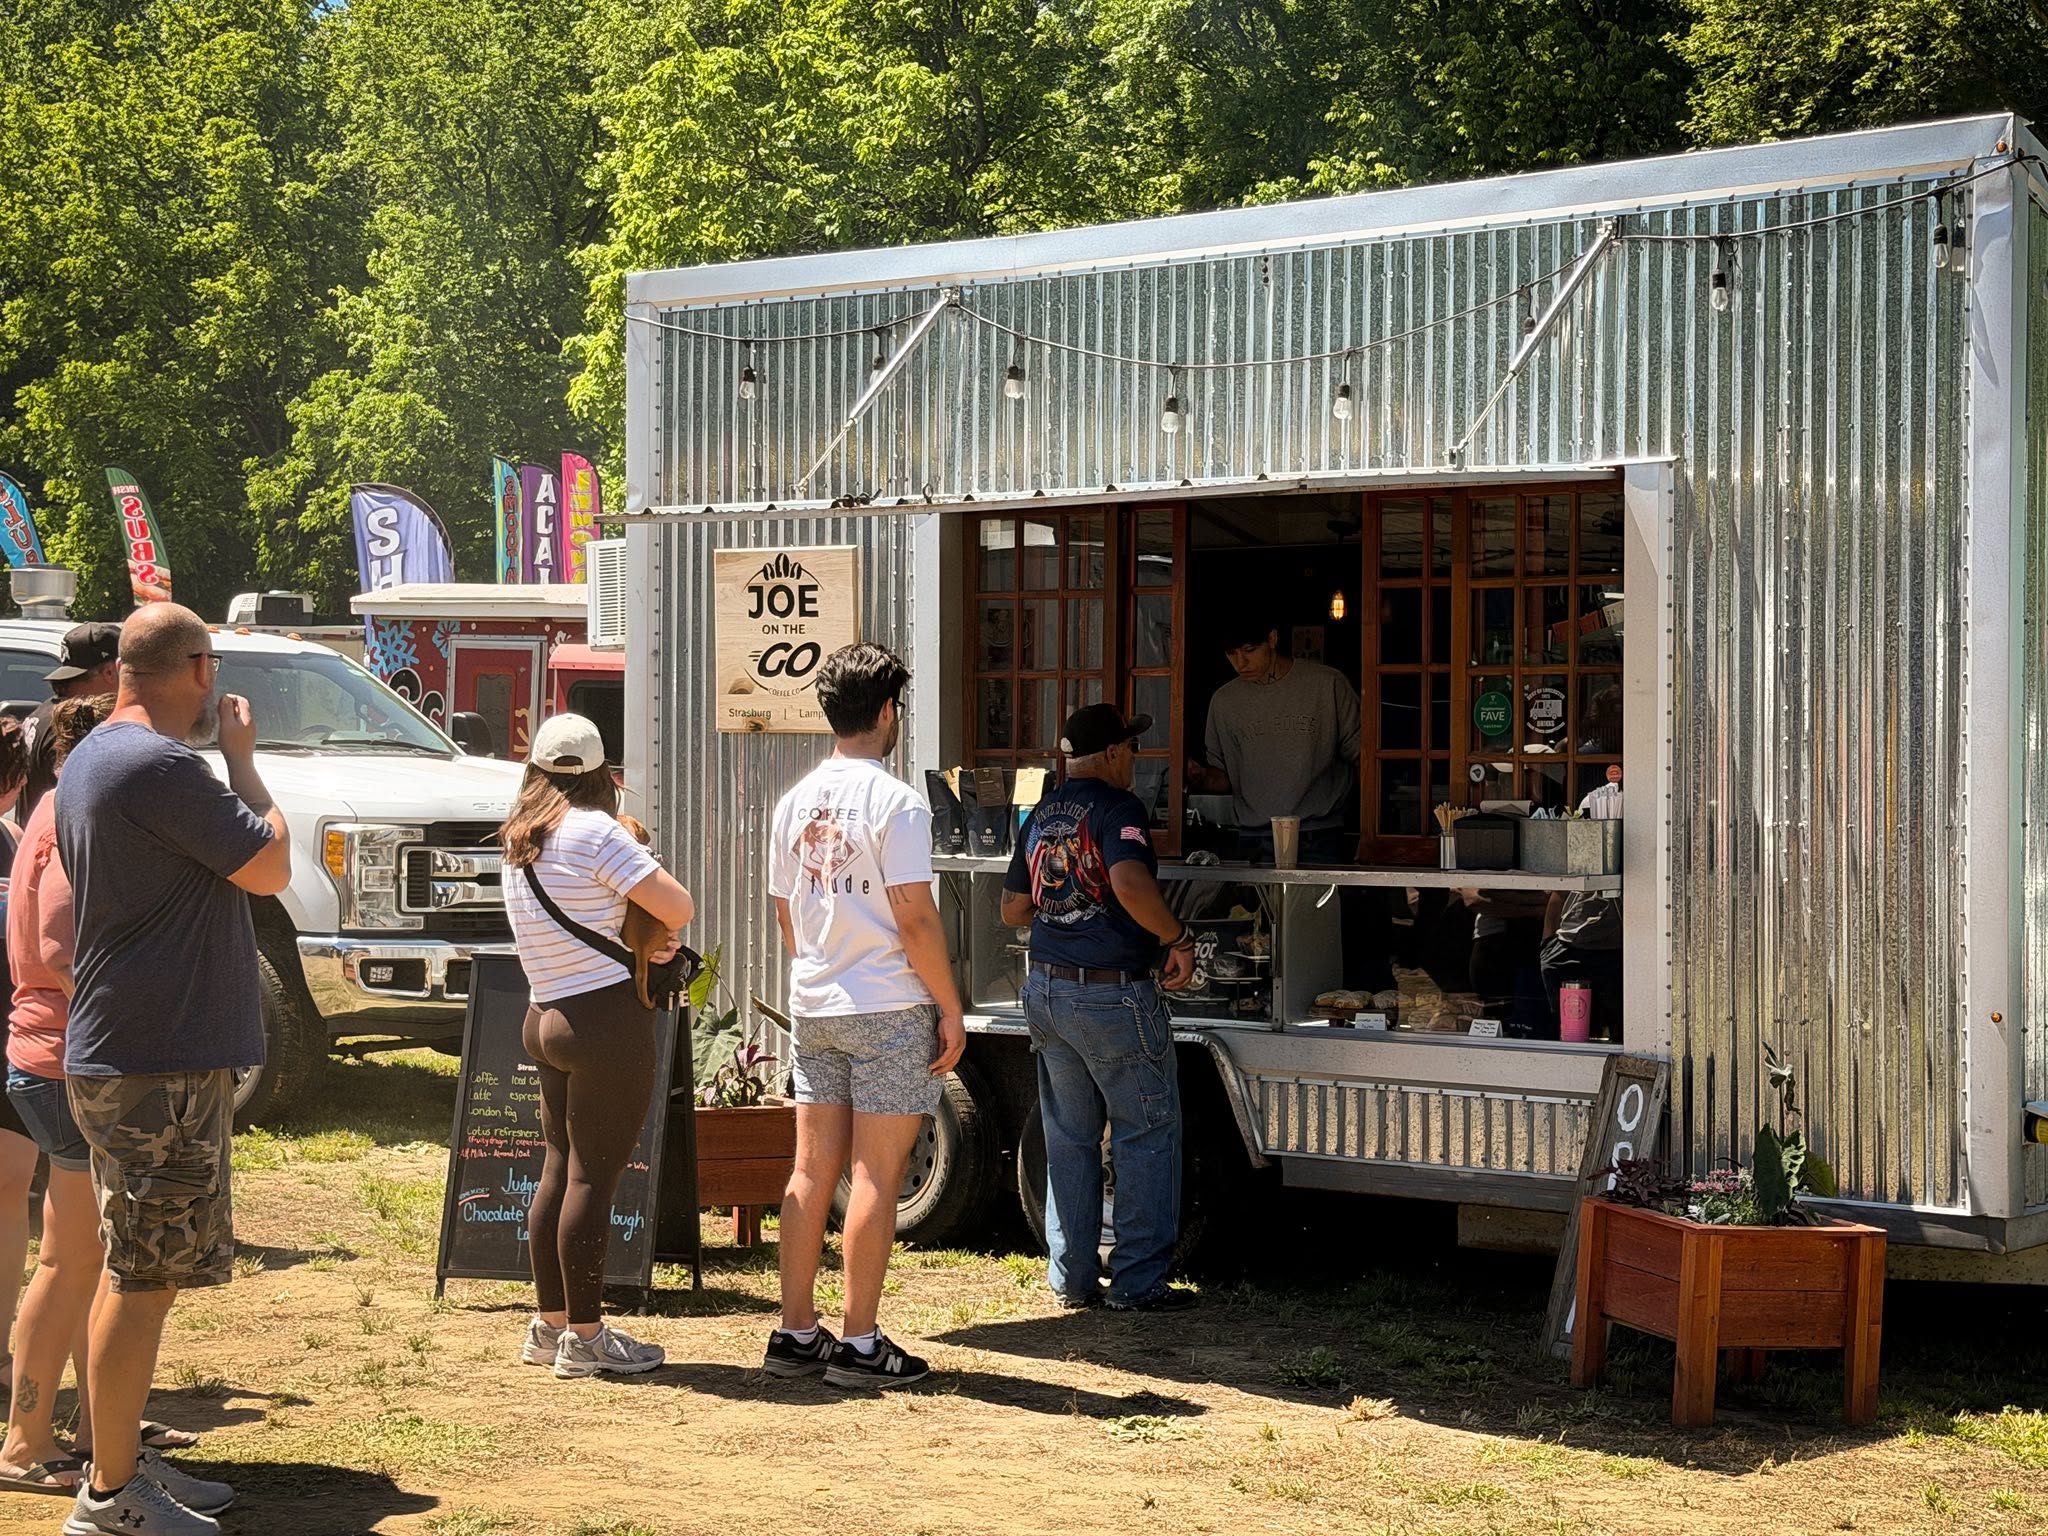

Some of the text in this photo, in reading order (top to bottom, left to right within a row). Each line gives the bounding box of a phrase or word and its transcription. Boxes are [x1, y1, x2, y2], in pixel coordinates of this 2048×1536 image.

[367, 507, 404, 592] SH
[748, 584, 819, 619] JOE
[762, 623, 805, 634] ON THE
[757, 641, 822, 678] GO
[768, 688, 790, 697] COFFEE
[729, 708, 772, 721] Strasburg
[1480, 711, 1505, 721] FAVE
[470, 1072, 500, 1086] Coffee
[469, 1088, 492, 1101] Latte
[468, 1103, 502, 1117] London
[466, 1126, 540, 1138] Lotus refreshers
[463, 1203, 524, 1223] Chocolate
[884, 1355, 903, 1374] N
